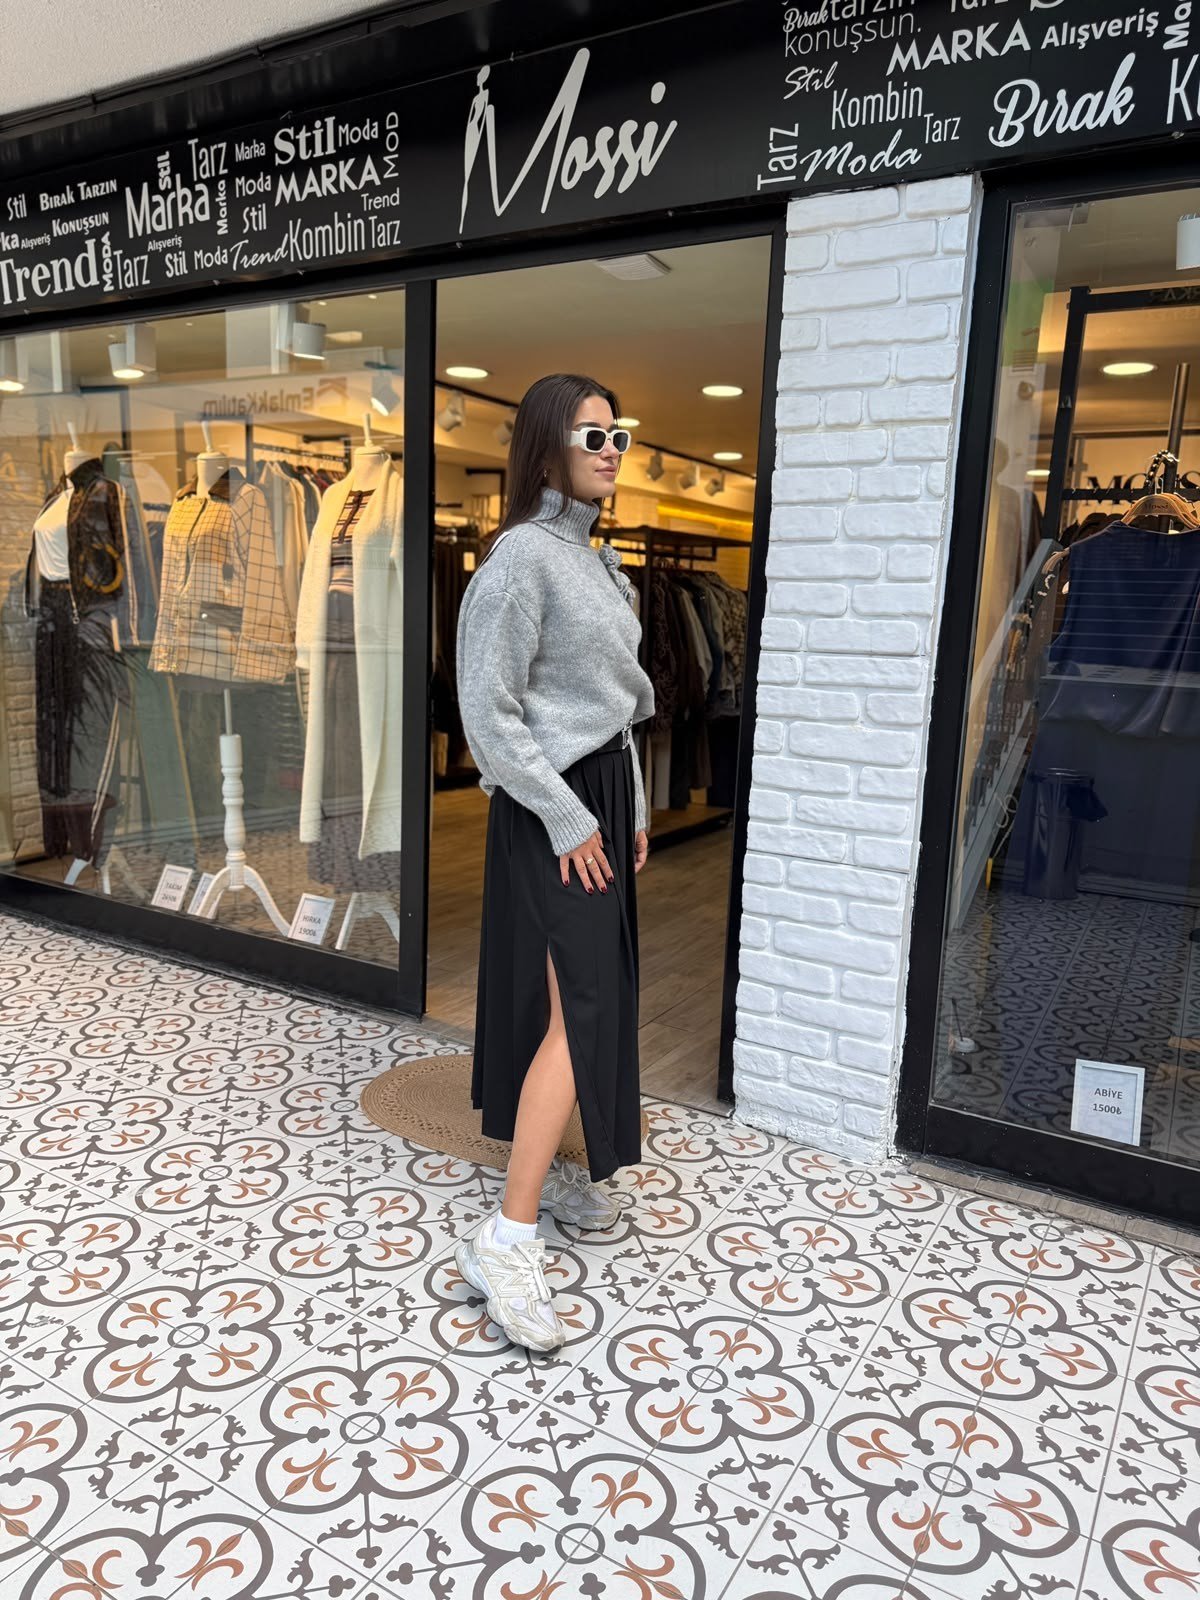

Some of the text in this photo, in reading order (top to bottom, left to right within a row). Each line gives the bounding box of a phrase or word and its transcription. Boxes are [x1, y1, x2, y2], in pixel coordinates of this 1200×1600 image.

[784, 12, 921, 57] konuşsun.
[885, 18, 1032, 76] MARKA
[1040, 8, 1159, 49] Alışveriş
[783, 61, 838, 99] Stil
[988, 52, 1136, 147] Bırak
[1166, 53, 1200, 125] K
[831, 80, 923, 131] Kombin
[273, 116, 337, 166] Stil
[338, 117, 379, 148] Moda
[457, 47, 678, 234] Mossi
[924, 112, 961, 144] Tarz
[187, 138, 229, 182] Tarz
[235, 139, 266, 163] Marka
[756, 122, 799, 191] Tarz
[799, 128, 922, 182] Moda
[235, 171, 272, 198] Moda
[274, 154, 381, 207] MARKA
[361, 187, 400, 211] Trend
[6, 193, 28, 222] Stil
[124, 173, 211, 239] Marka
[214, 179, 229, 236] Marka
[242, 203, 267, 234] Stil
[0, 231, 51, 252] ka Alışveriş
[147, 234, 183, 252] Alışveriş
[229, 233, 290, 272] Trend
[289, 211, 366, 262] Kombin
[368, 215, 401, 249] Tarz
[0, 238, 100, 305] Trend
[101, 231, 115, 292] MODA
[113, 249, 151, 290] Tarz
[164, 250, 188, 278] Stil
[193, 245, 228, 270] Moda
[1093, 1103, 1122, 1115] 1500₺
[1094, 1087, 1123, 1100] ABİYE
